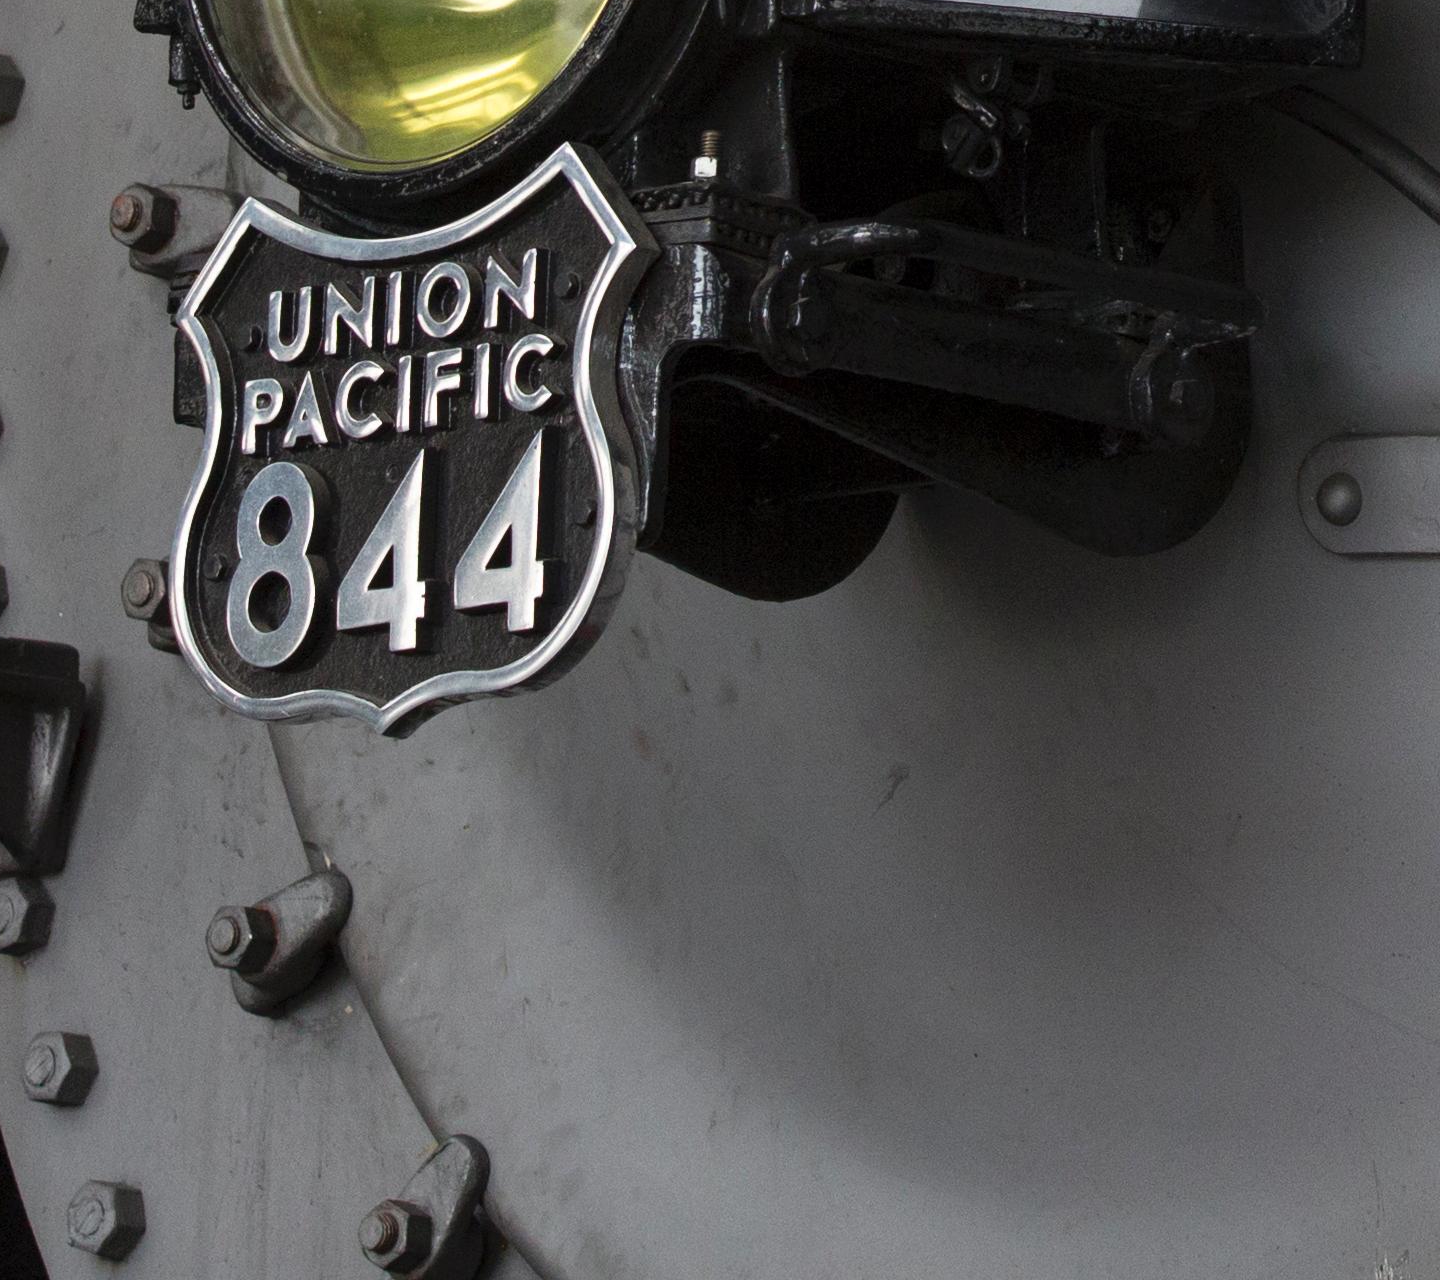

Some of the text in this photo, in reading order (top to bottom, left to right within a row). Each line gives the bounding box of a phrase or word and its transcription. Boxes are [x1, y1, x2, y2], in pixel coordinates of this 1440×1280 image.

[268, 247, 540, 363] UNION
[241, 333, 556, 455] PACIFIC
[225, 427, 545, 668] 844
